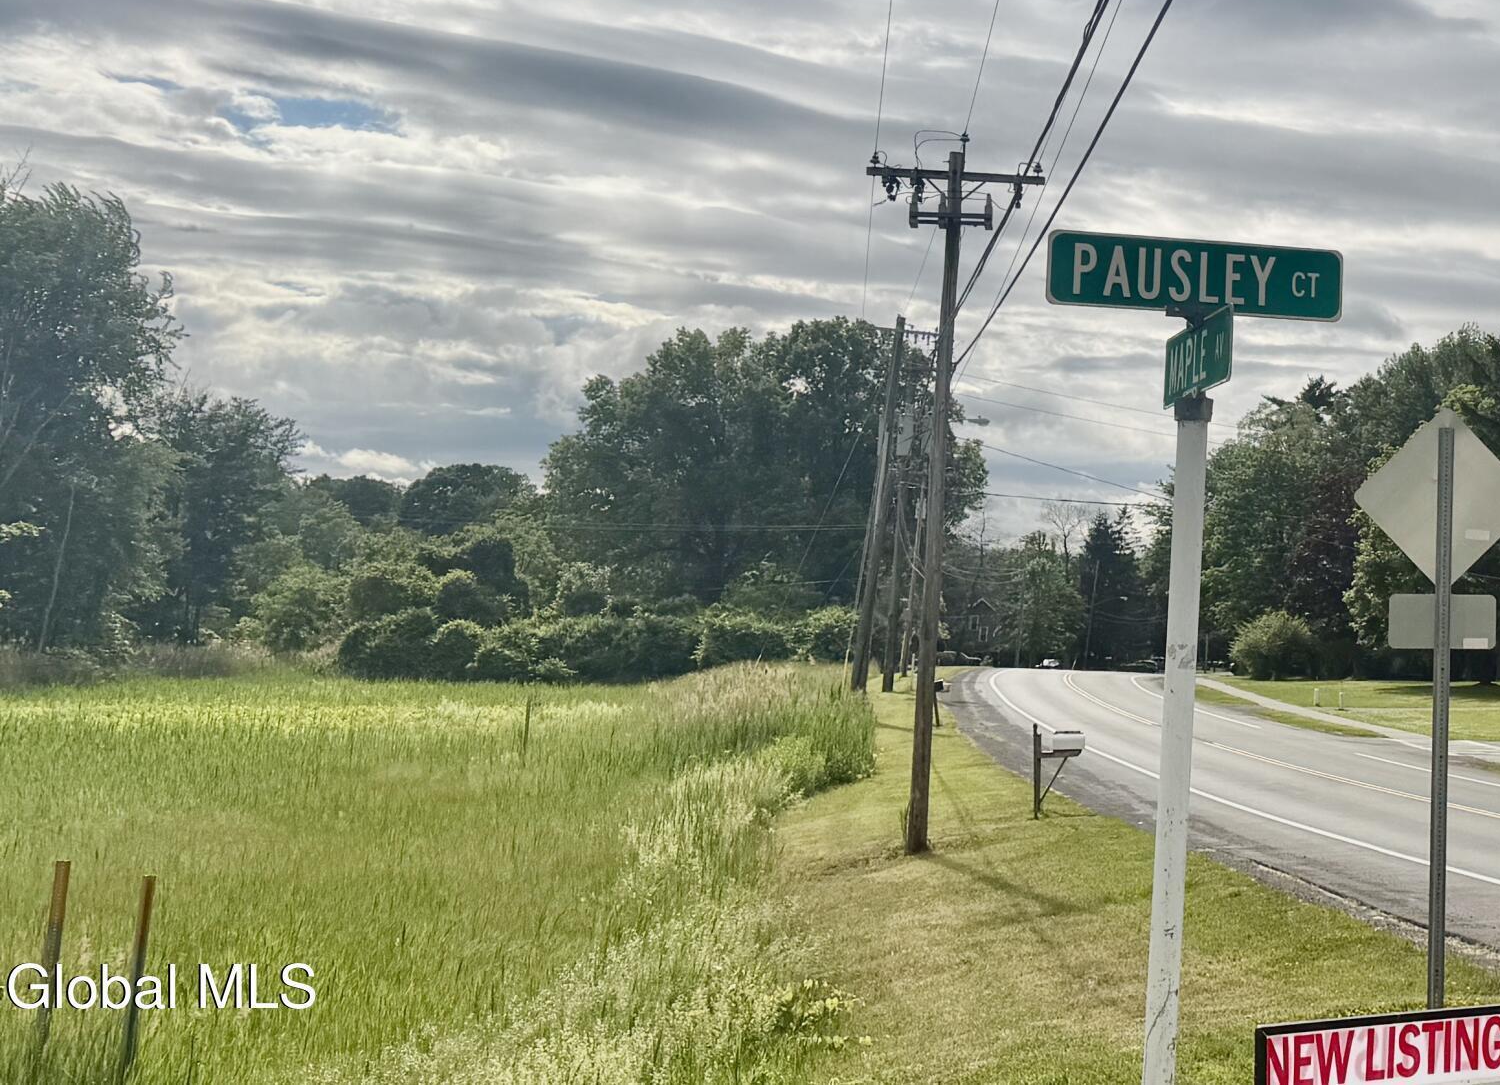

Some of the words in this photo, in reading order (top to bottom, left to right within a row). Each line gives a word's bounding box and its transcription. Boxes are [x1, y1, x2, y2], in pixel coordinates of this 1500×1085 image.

[1072, 243, 1276, 306] PAUSLEY
[1291, 272, 1320, 299] CT
[1168, 329, 1208, 395] MAPLE
[1267, 1030, 1355, 1085] NEW
